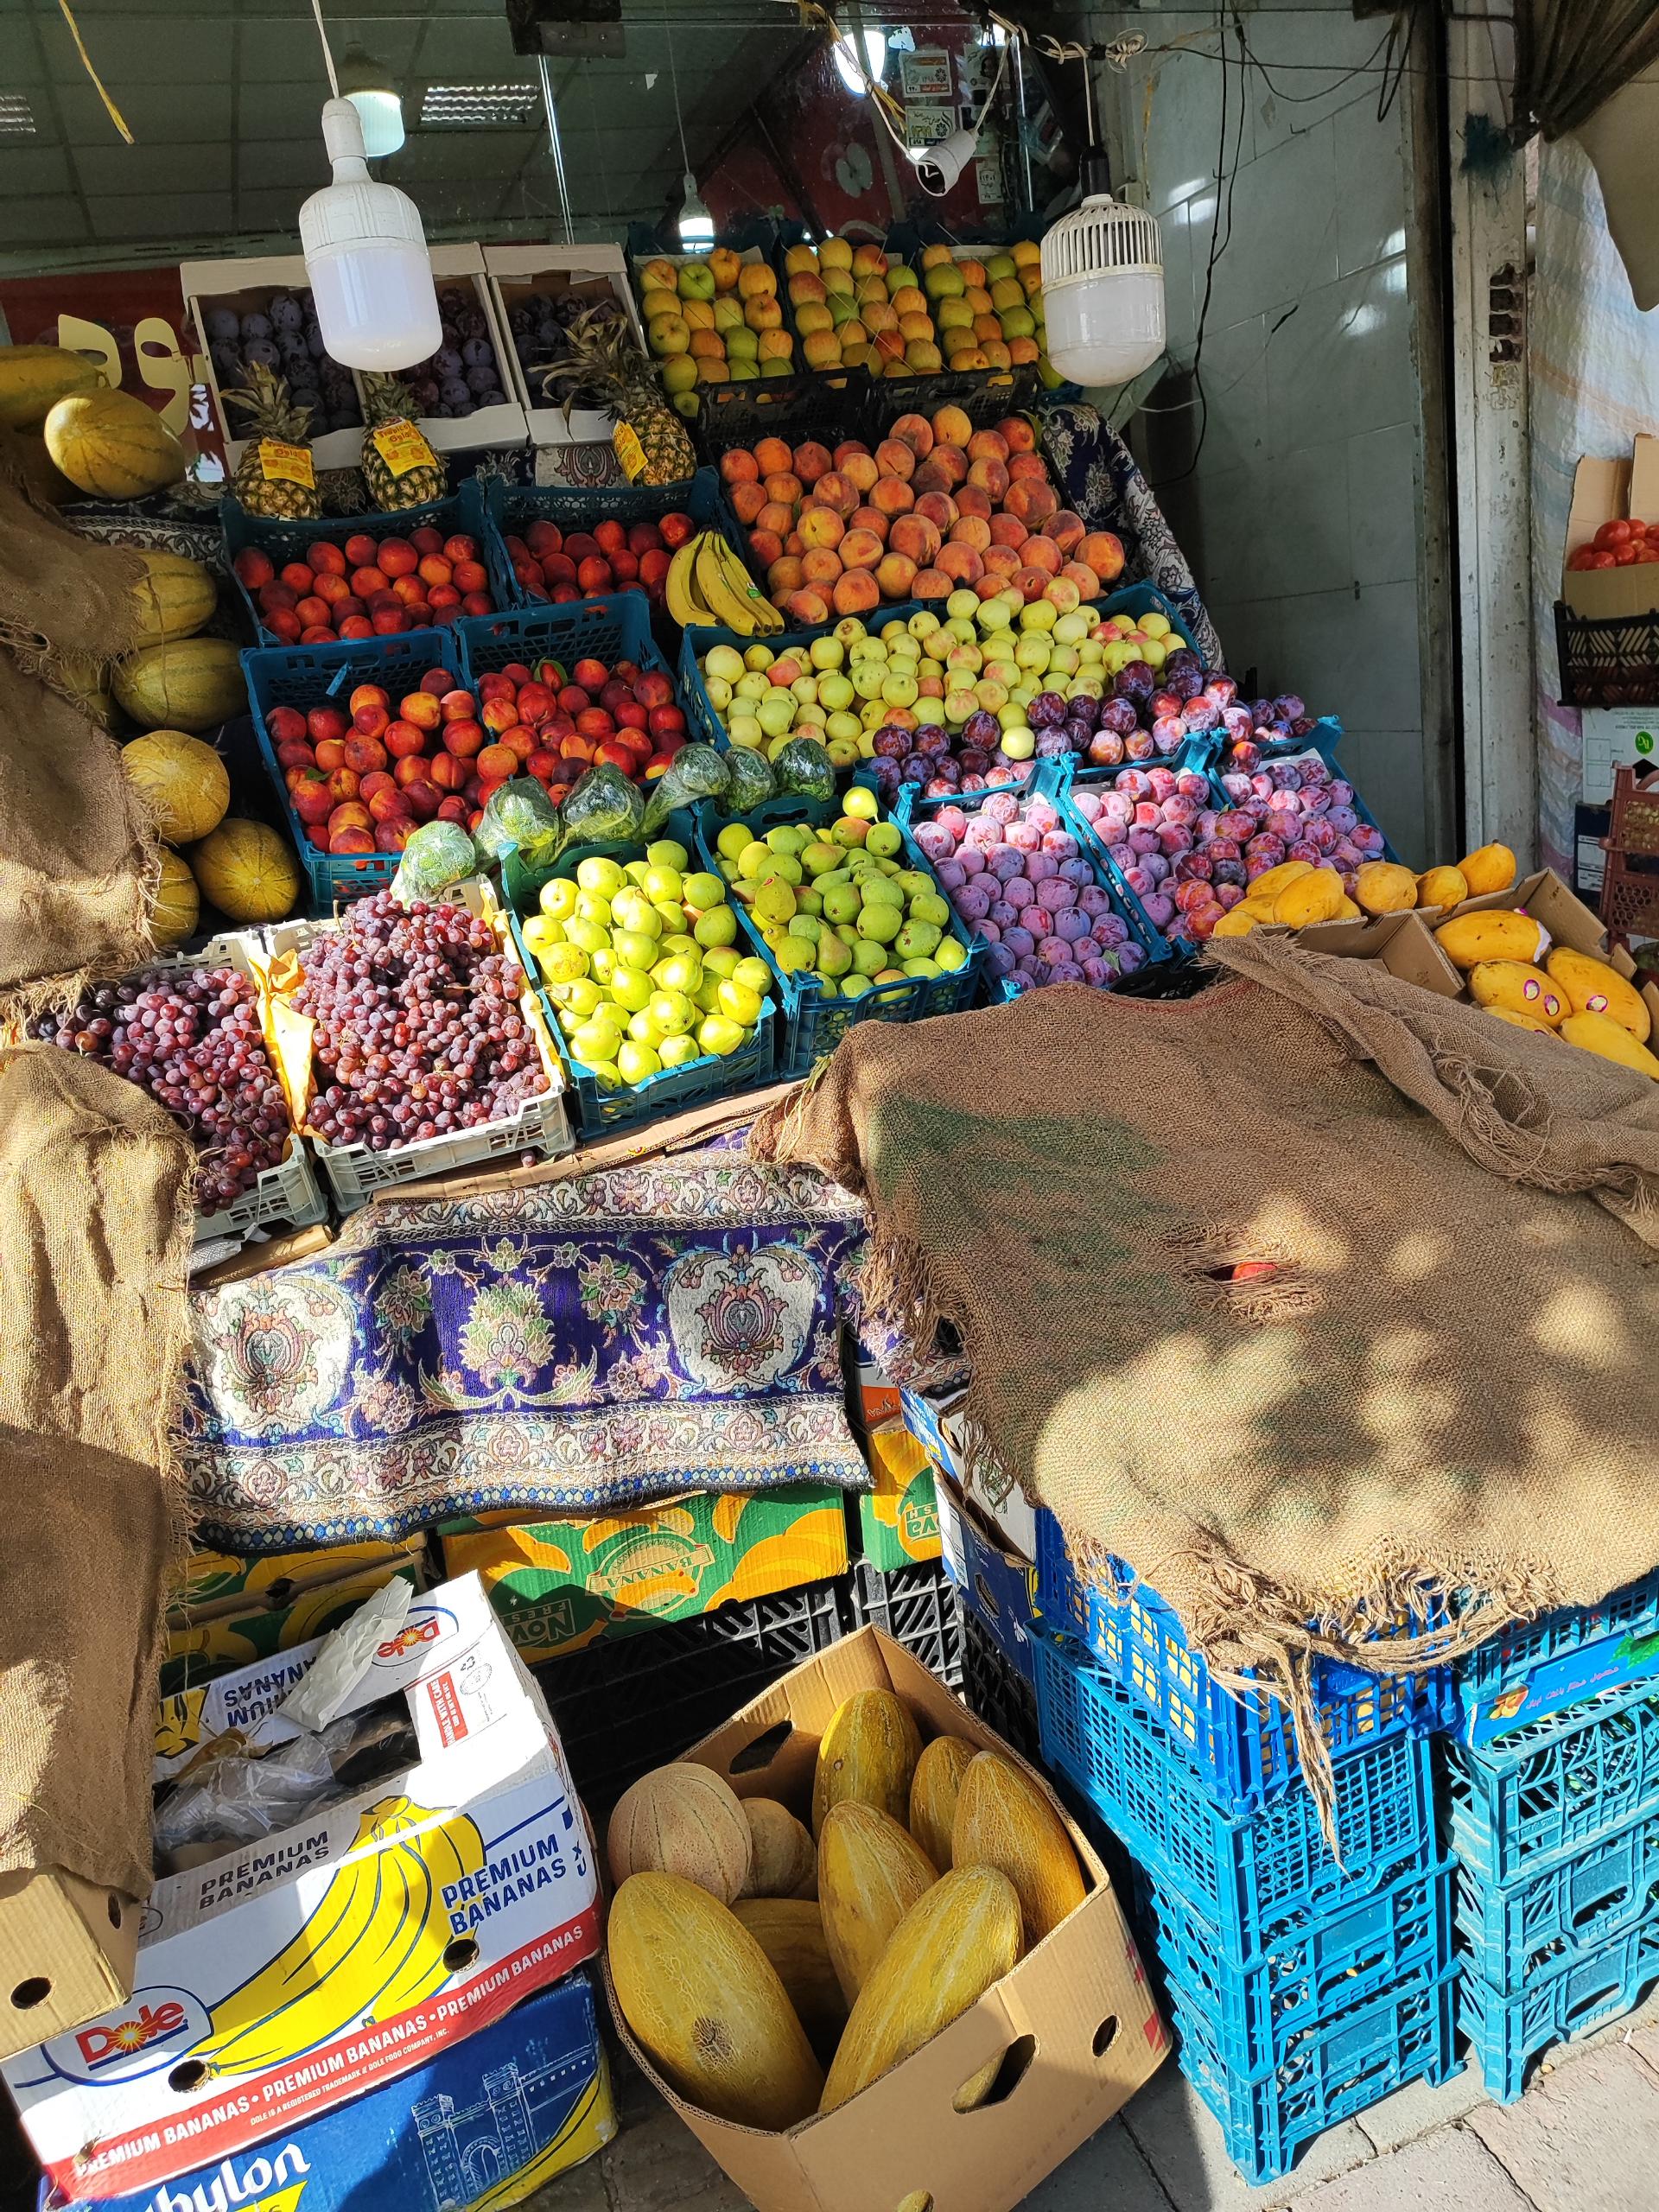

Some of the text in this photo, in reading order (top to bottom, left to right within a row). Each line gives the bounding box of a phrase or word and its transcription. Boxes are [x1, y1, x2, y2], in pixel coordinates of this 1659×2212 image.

[607, 1555, 692, 1589] BANANA
[377, 1619, 441, 1659] Dole
[224, 1656, 317, 1707] ANANAS
[200, 1847, 330, 1910] BANANAS
[201, 1830, 328, 1896] PREMIUM
[442, 1833, 559, 1910] PREMIUM
[449, 1858, 567, 1936] BANANAS
[75, 2002, 184, 2064] Dole
[163, 2095, 251, 2145] BANANAS
[262, 2051, 345, 2102] PREMIUM
[346, 2014, 428, 2064] BANANAS
[436, 1967, 511, 2022] PREMIUM
[512, 1925, 584, 1977] BANANAS
[250, 2112, 268, 2126] DOLE
[282, 2087, 321, 2112] REGISTERED
[321, 2068, 362, 2094] TRADEMARK
[368, 2056, 385, 2071] DOLE
[385, 2049, 403, 2063] FOOD
